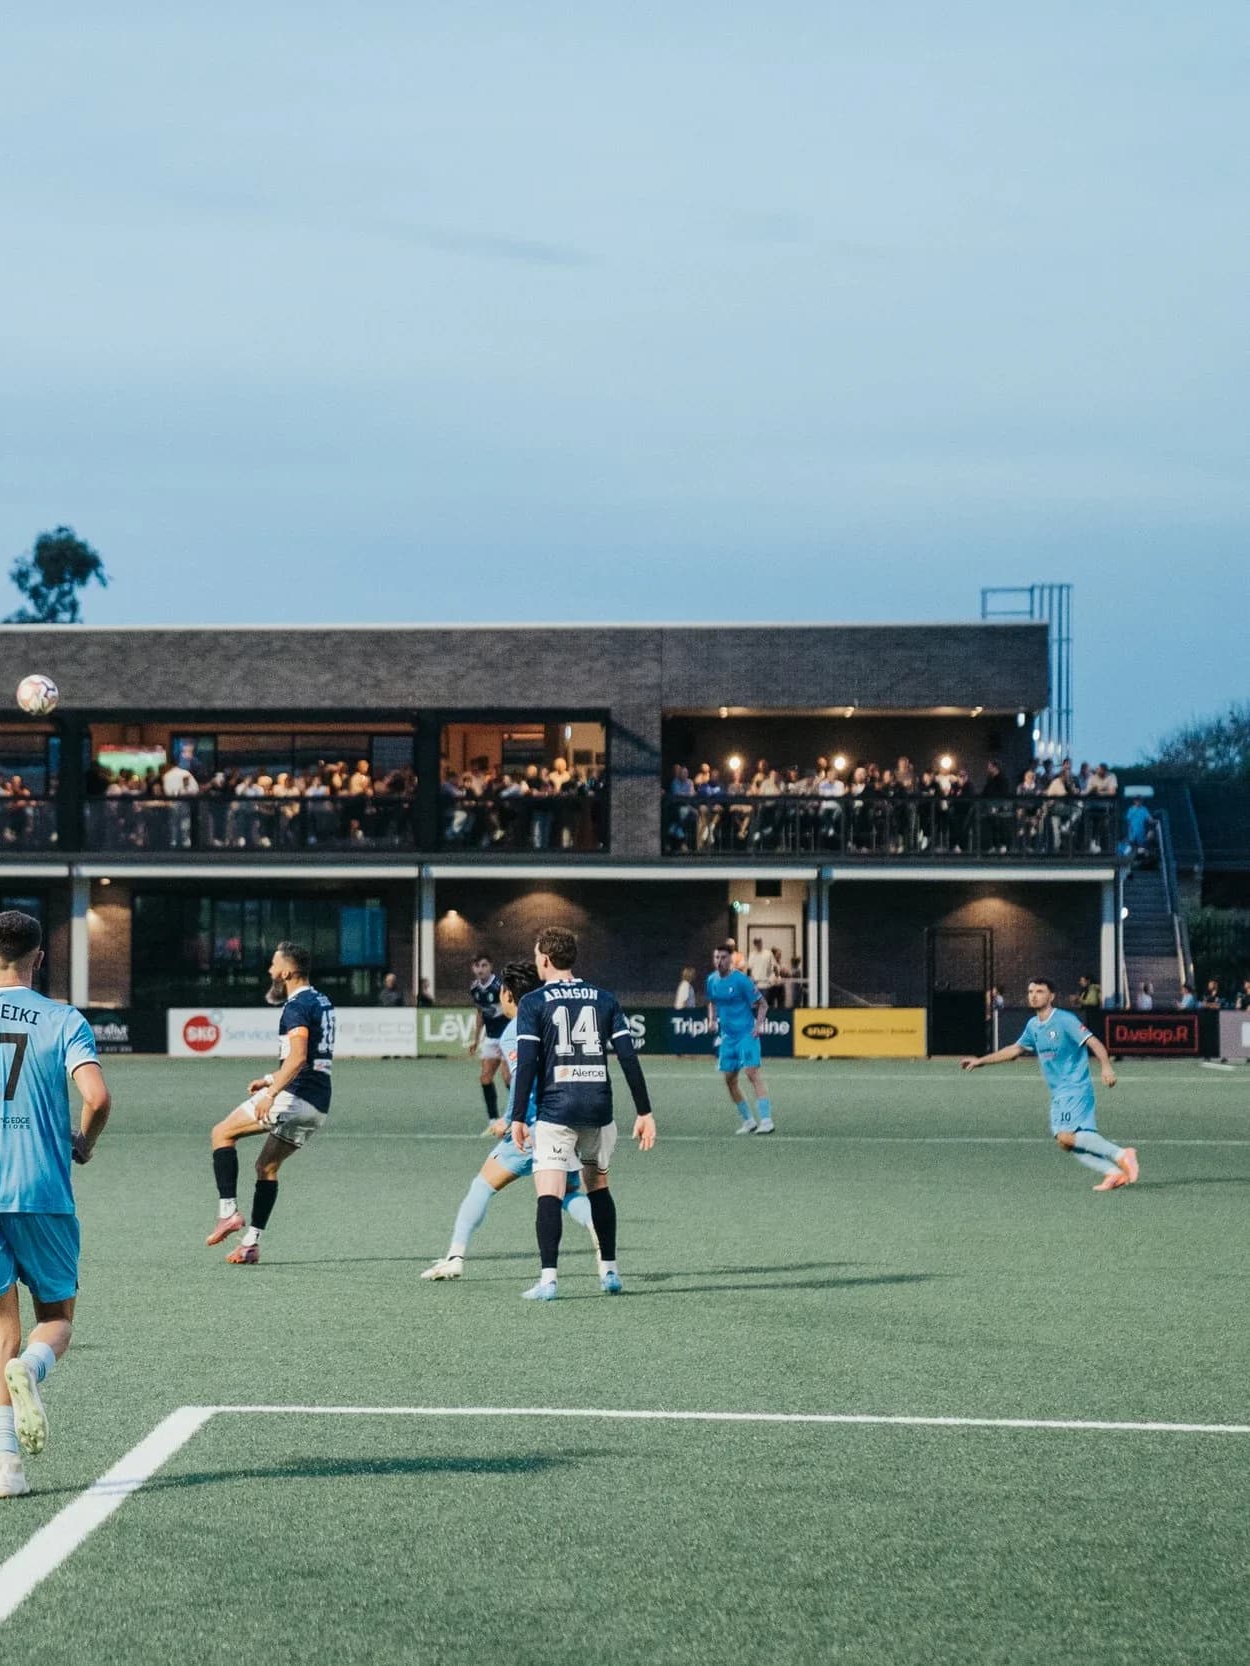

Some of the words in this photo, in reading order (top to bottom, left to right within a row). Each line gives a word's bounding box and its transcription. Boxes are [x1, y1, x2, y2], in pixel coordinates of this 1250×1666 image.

[543, 987, 599, 1002] ARMSON
[551, 1005, 603, 1057] 14
[572, 1068, 605, 1078] Alerce
